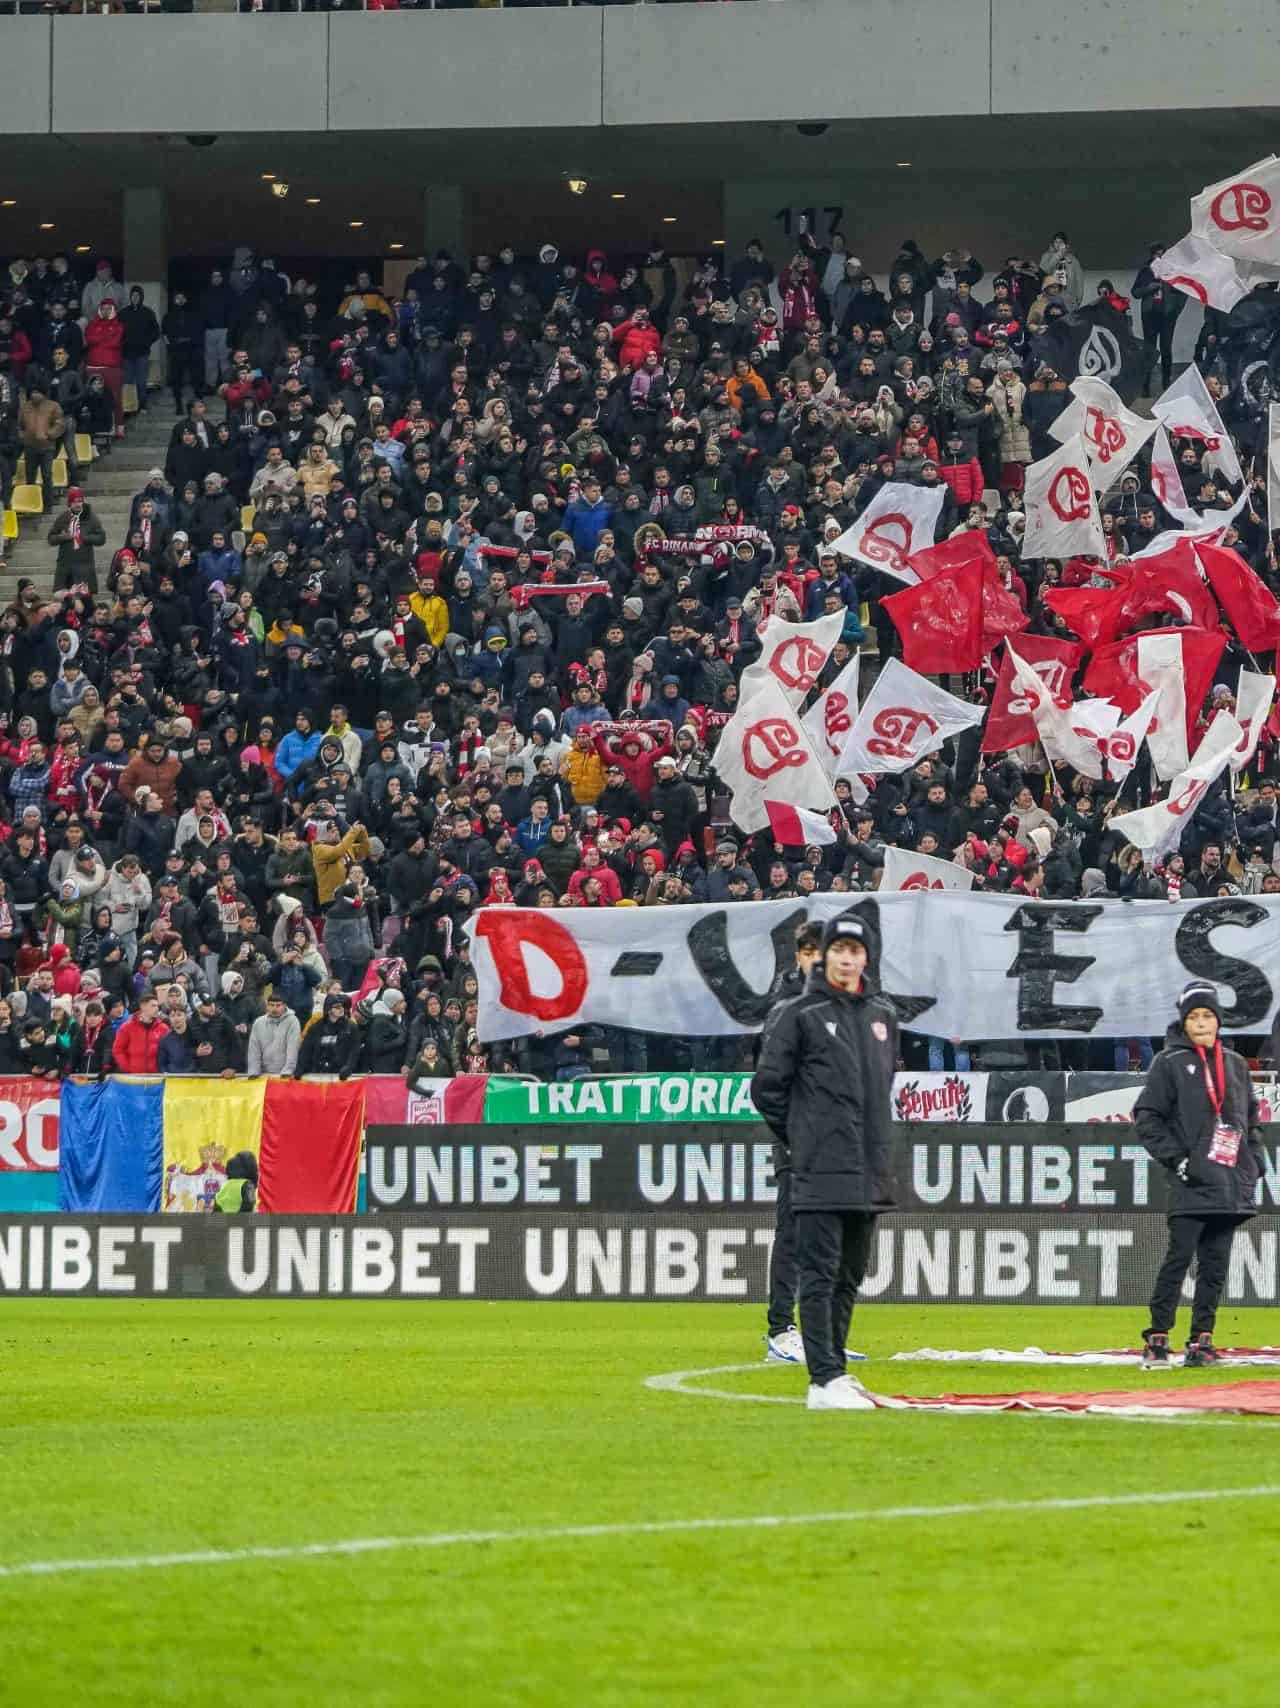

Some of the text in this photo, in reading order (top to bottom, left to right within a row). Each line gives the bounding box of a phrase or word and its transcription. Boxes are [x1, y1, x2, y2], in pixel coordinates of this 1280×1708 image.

[775, 206, 843, 234] 117
[1003, 903, 1104, 1032] E
[368, 1144, 603, 1203] UNIBET
[638, 1144, 778, 1203] UNIB
[912, 1144, 1154, 1205] UNIBET
[228, 1228, 489, 1293] UNIBET
